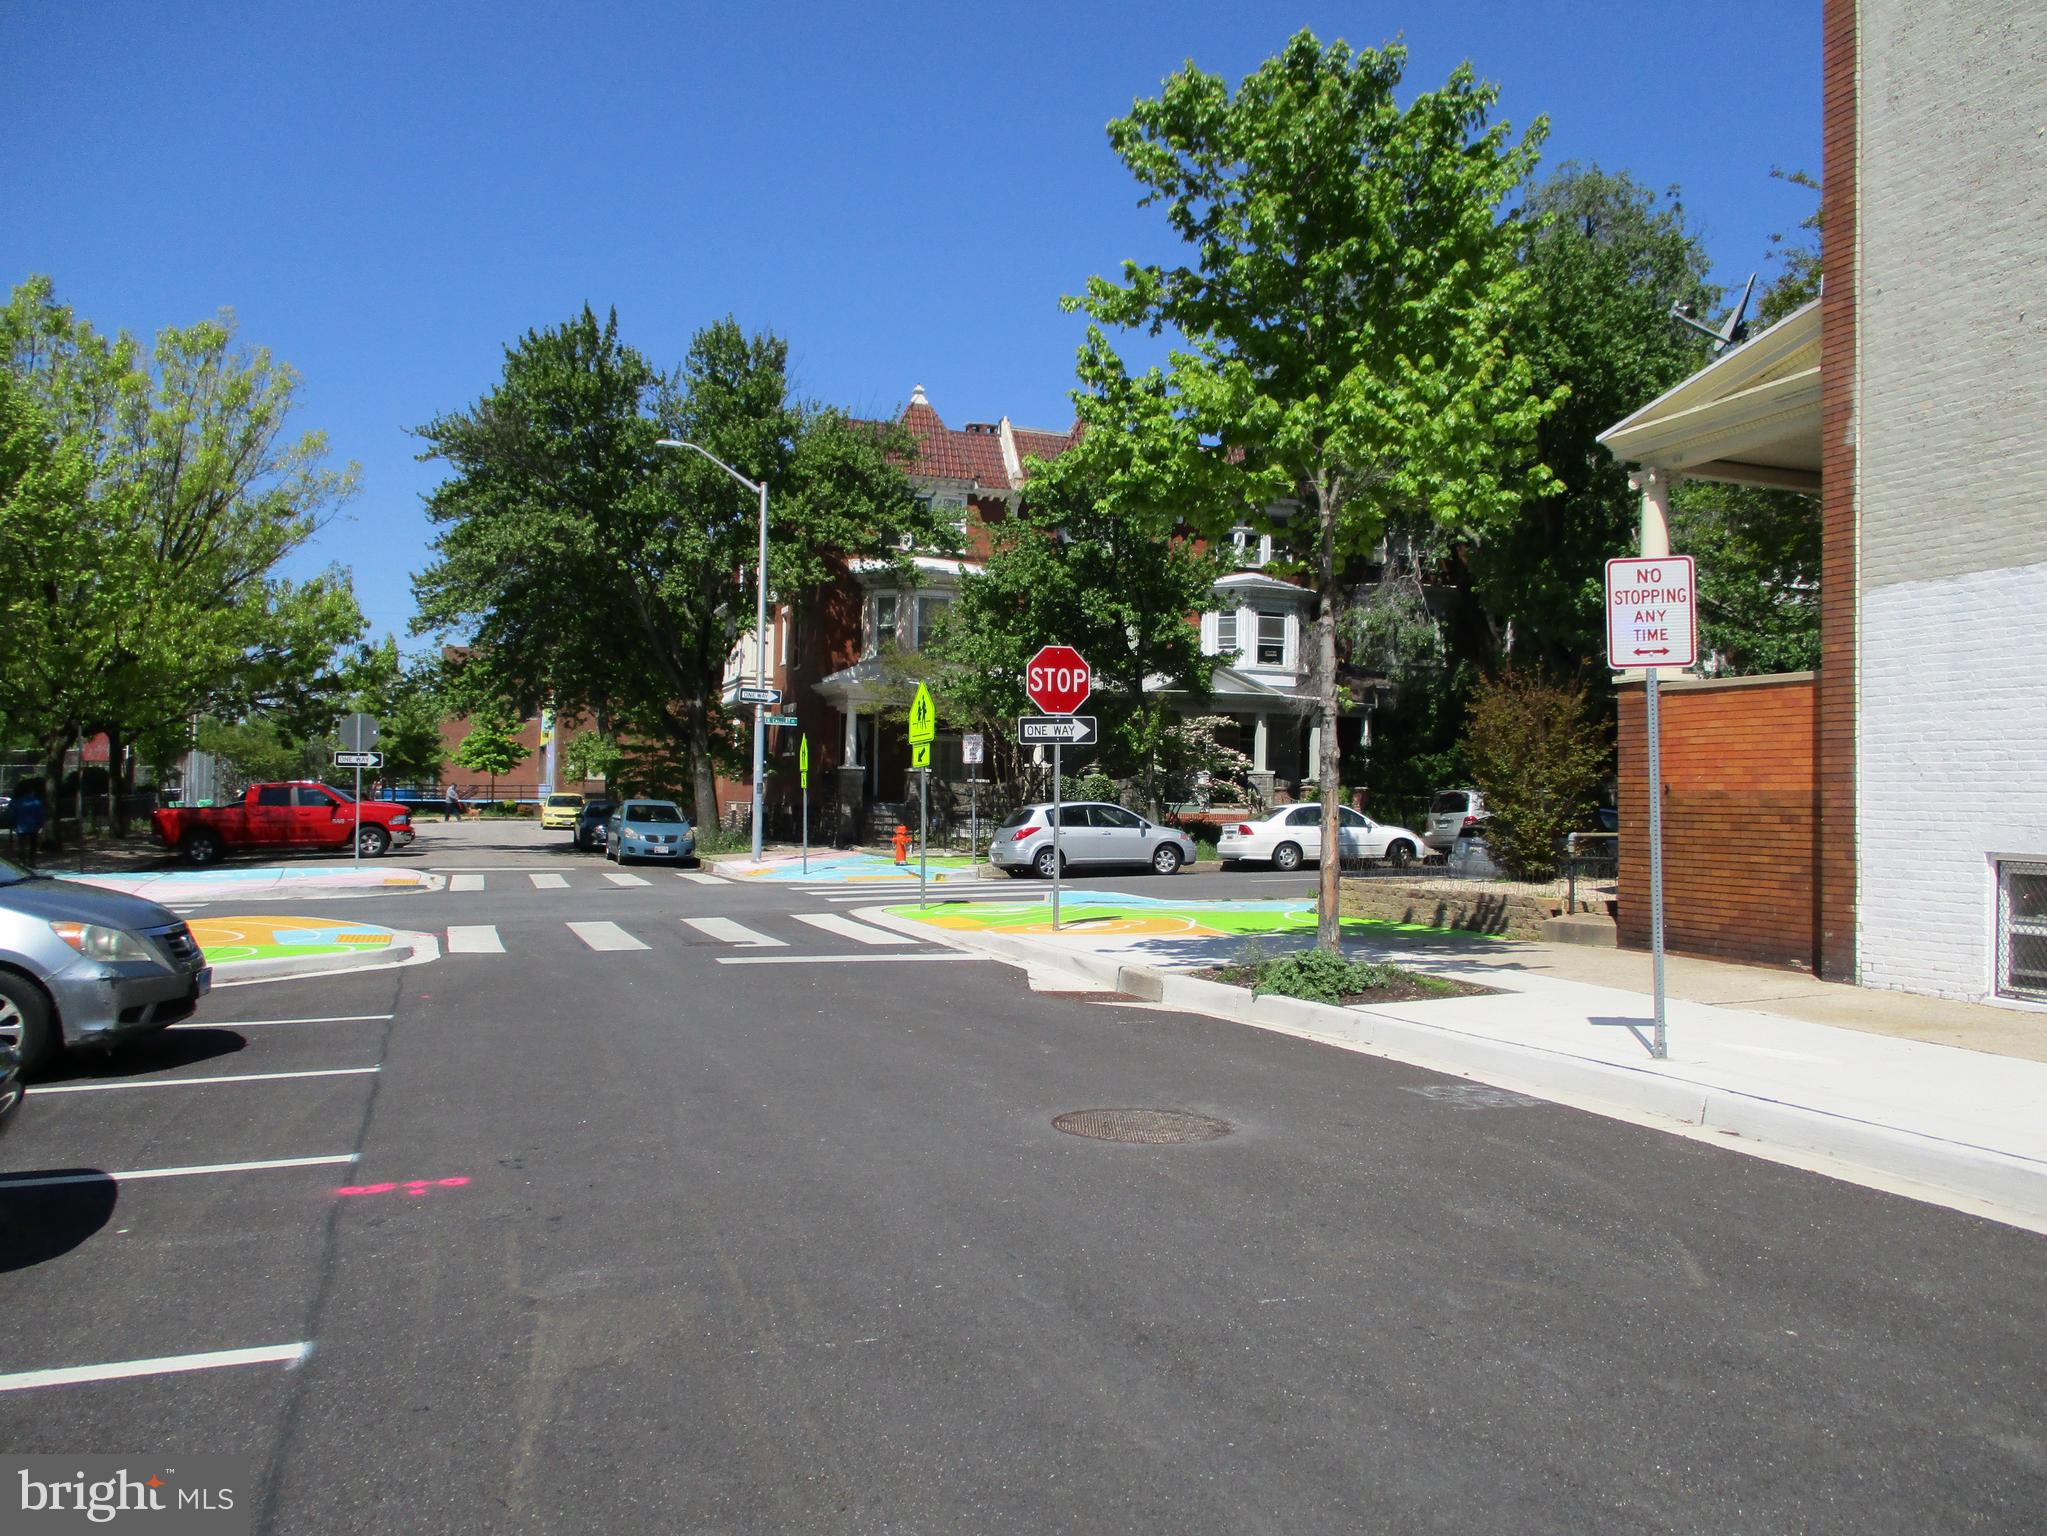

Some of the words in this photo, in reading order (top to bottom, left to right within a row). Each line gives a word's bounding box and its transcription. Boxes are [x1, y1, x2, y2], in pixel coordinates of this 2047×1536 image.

[1636, 568, 1662, 584] NO
[1614, 588, 1687, 605] STOPPING
[1634, 609, 1667, 623] ANY
[1633, 628, 1669, 641] TIME
[1030, 667, 1087, 693] STOP
[1027, 725, 1048, 736] ONE
[1053, 725, 1075, 735] WAY
